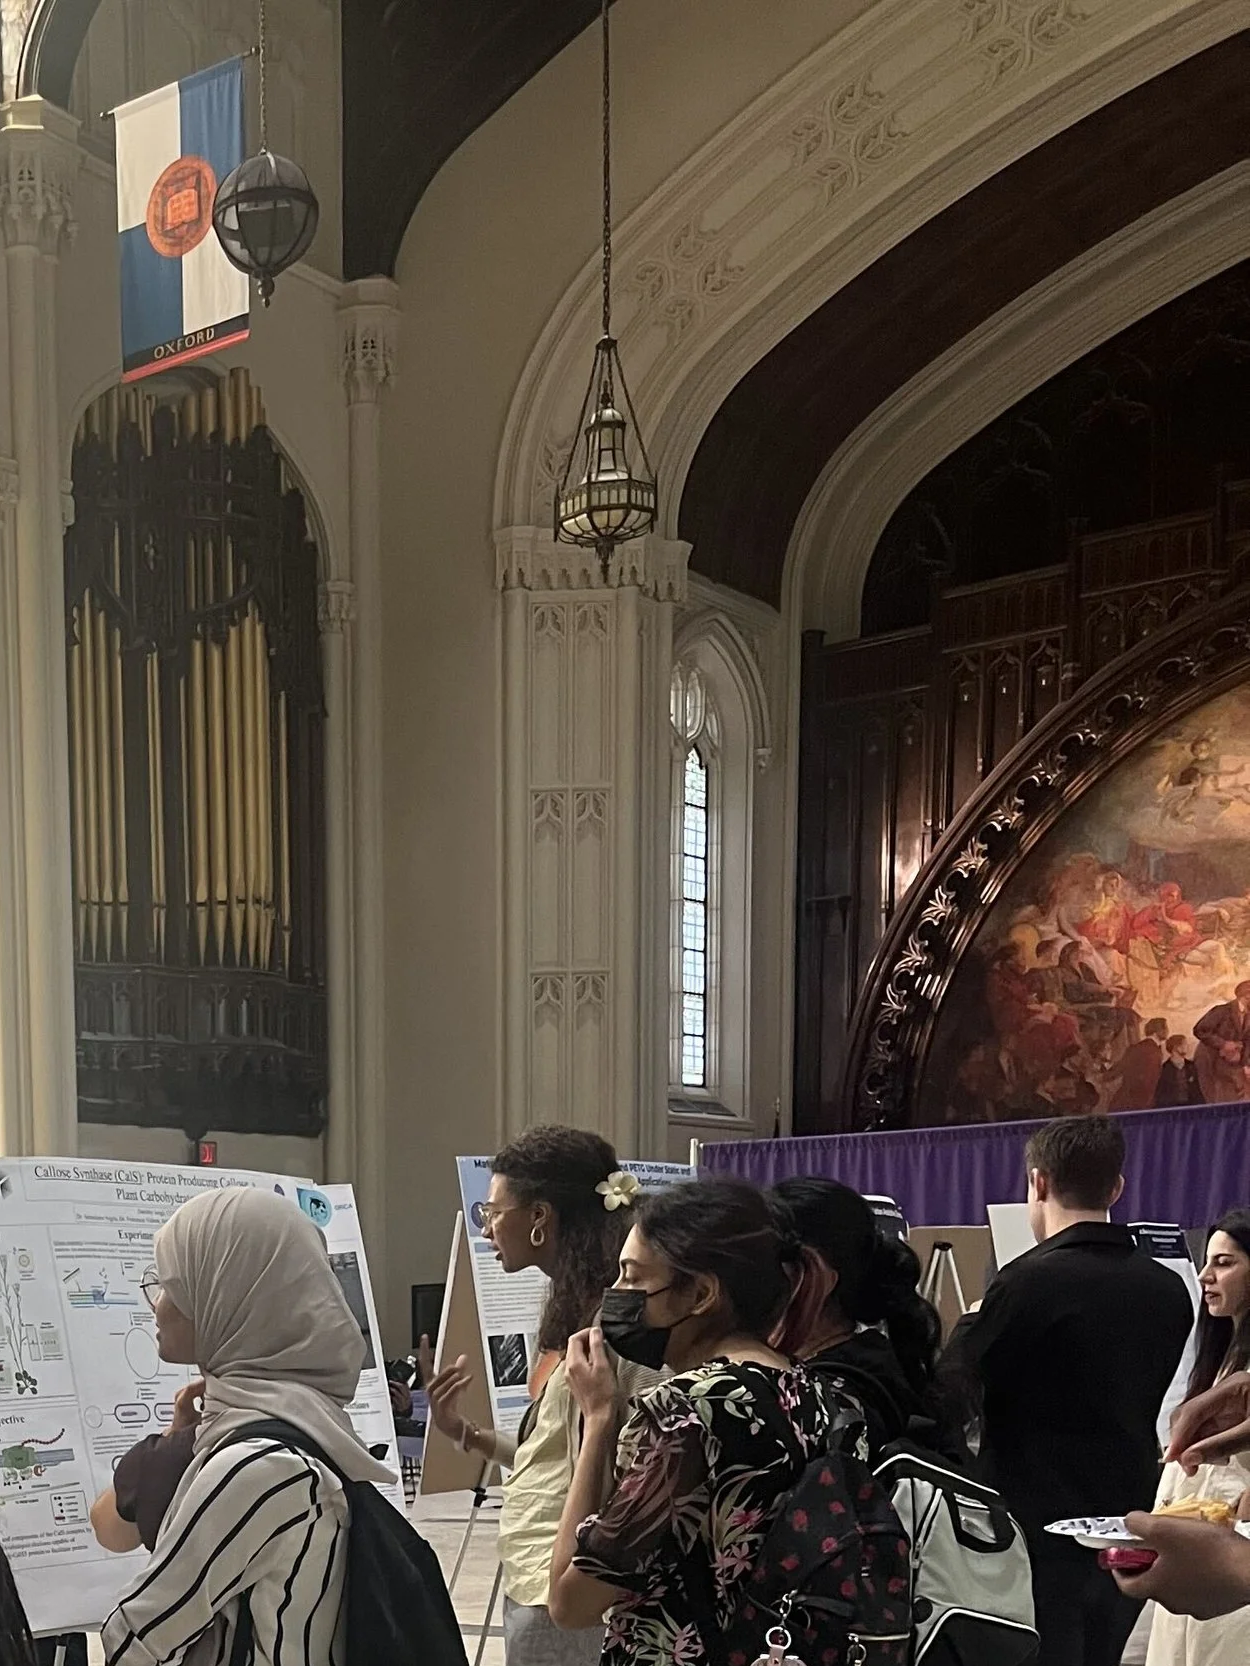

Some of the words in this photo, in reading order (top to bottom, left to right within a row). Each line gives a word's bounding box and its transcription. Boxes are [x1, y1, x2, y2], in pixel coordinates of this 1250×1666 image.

[153, 328, 215, 360] OXFORD
[645, 1164, 664, 1173] Under
[665, 1165, 680, 1175] Static
[34, 1165, 71, 1178] Callose
[73, 1167, 112, 1181] Synthase
[147, 1172, 176, 1186] Protein
[178, 1174, 218, 1188] Producing
[116, 1188, 138, 1200] Plant
[118, 1230, 154, 1241] Experime
